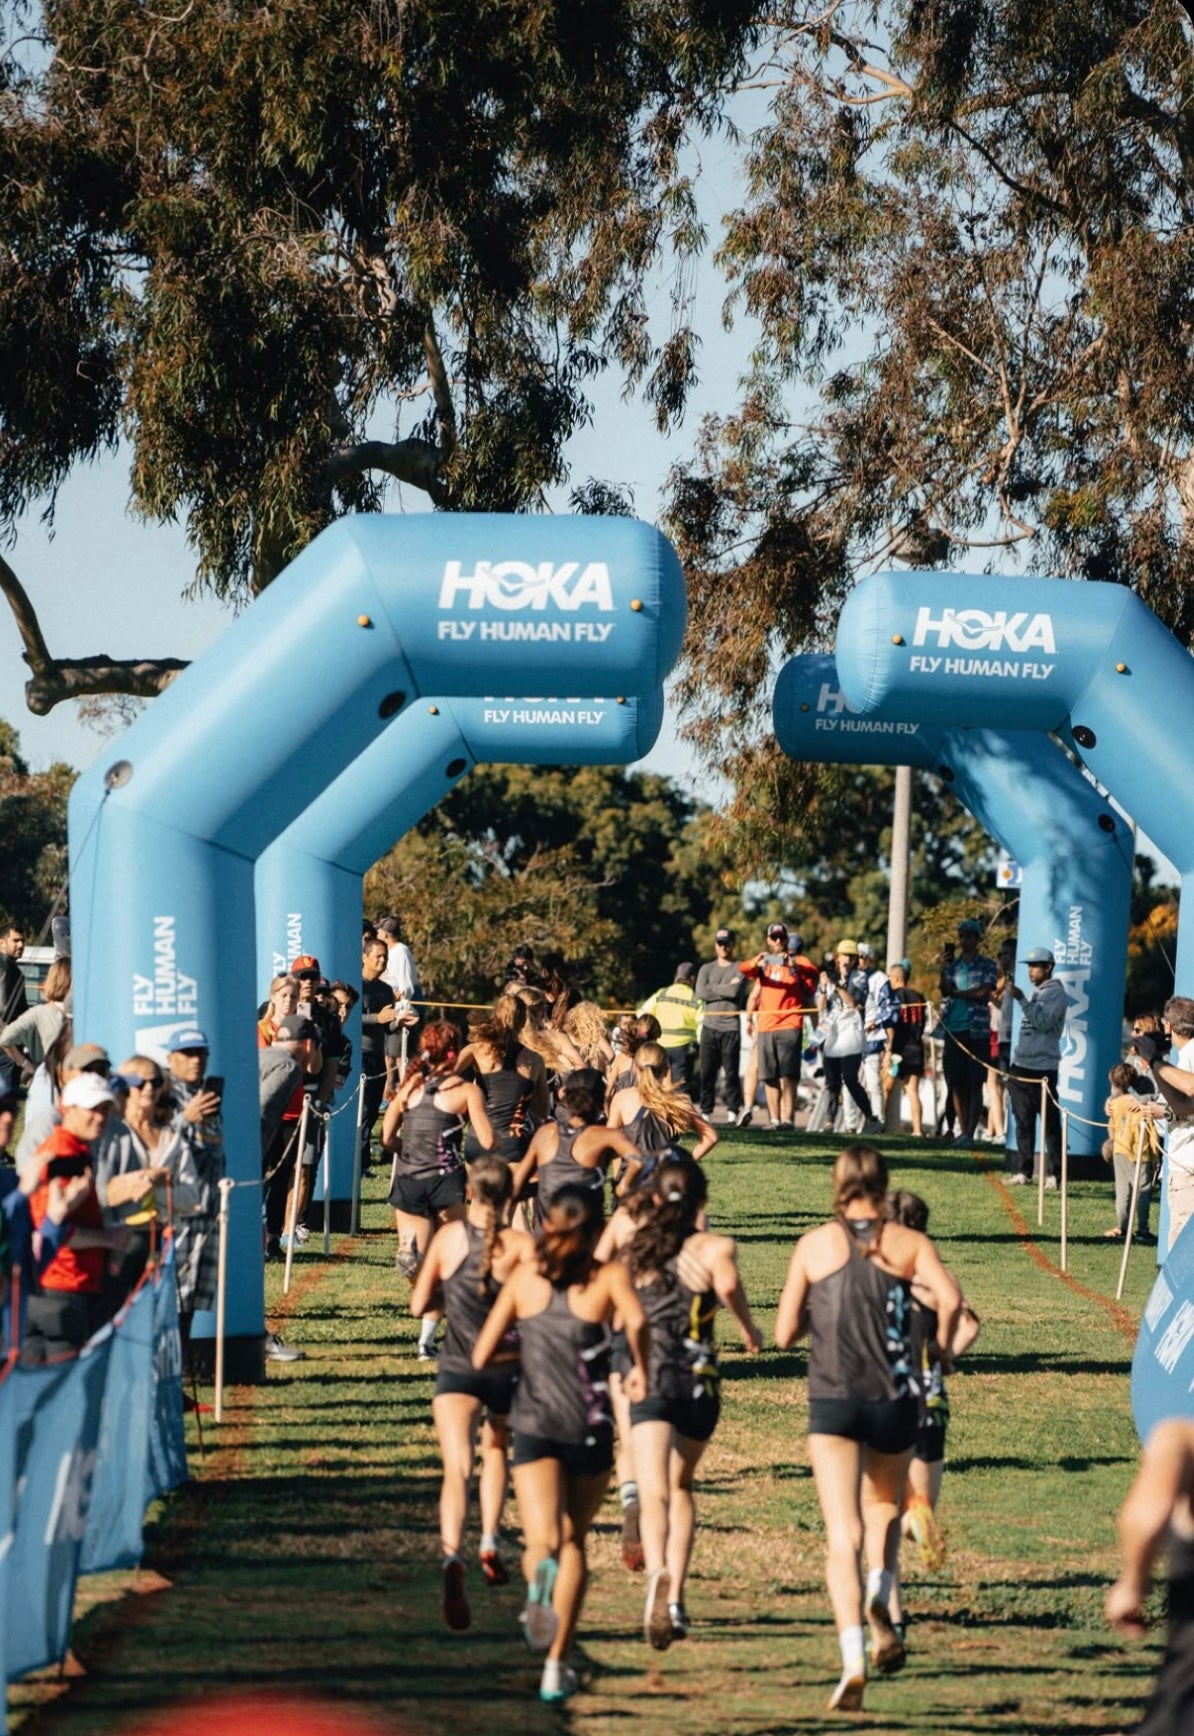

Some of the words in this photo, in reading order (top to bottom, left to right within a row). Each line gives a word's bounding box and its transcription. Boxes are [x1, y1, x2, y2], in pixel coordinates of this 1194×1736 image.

[438, 560, 614, 611] HOKA
[437, 621, 476, 640] FLY
[480, 621, 571, 641] HUMAN
[574, 623, 613, 642] FLY
[912, 606, 1056, 654] HOKA
[909, 655, 942, 672] FLY
[944, 657, 1019, 678] HUMAN
[1021, 663, 1054, 679] FLY
[484, 709, 510, 723] FLY
[513, 710, 575, 724] HUMAN
[578, 711, 604, 724] FLY
[815, 718, 838, 731] FLY
[840, 720, 894, 733] HUMAN
[896, 722, 920, 735] FLY
[1054, 938, 1067, 964] FLY
[1067, 906, 1083, 965] HUMAN
[154, 916, 176, 1015] HUMAN
[1079, 940, 1093, 966] FLY
[133, 973, 154, 1015] FLY
[177, 972, 197, 1015] FLY
